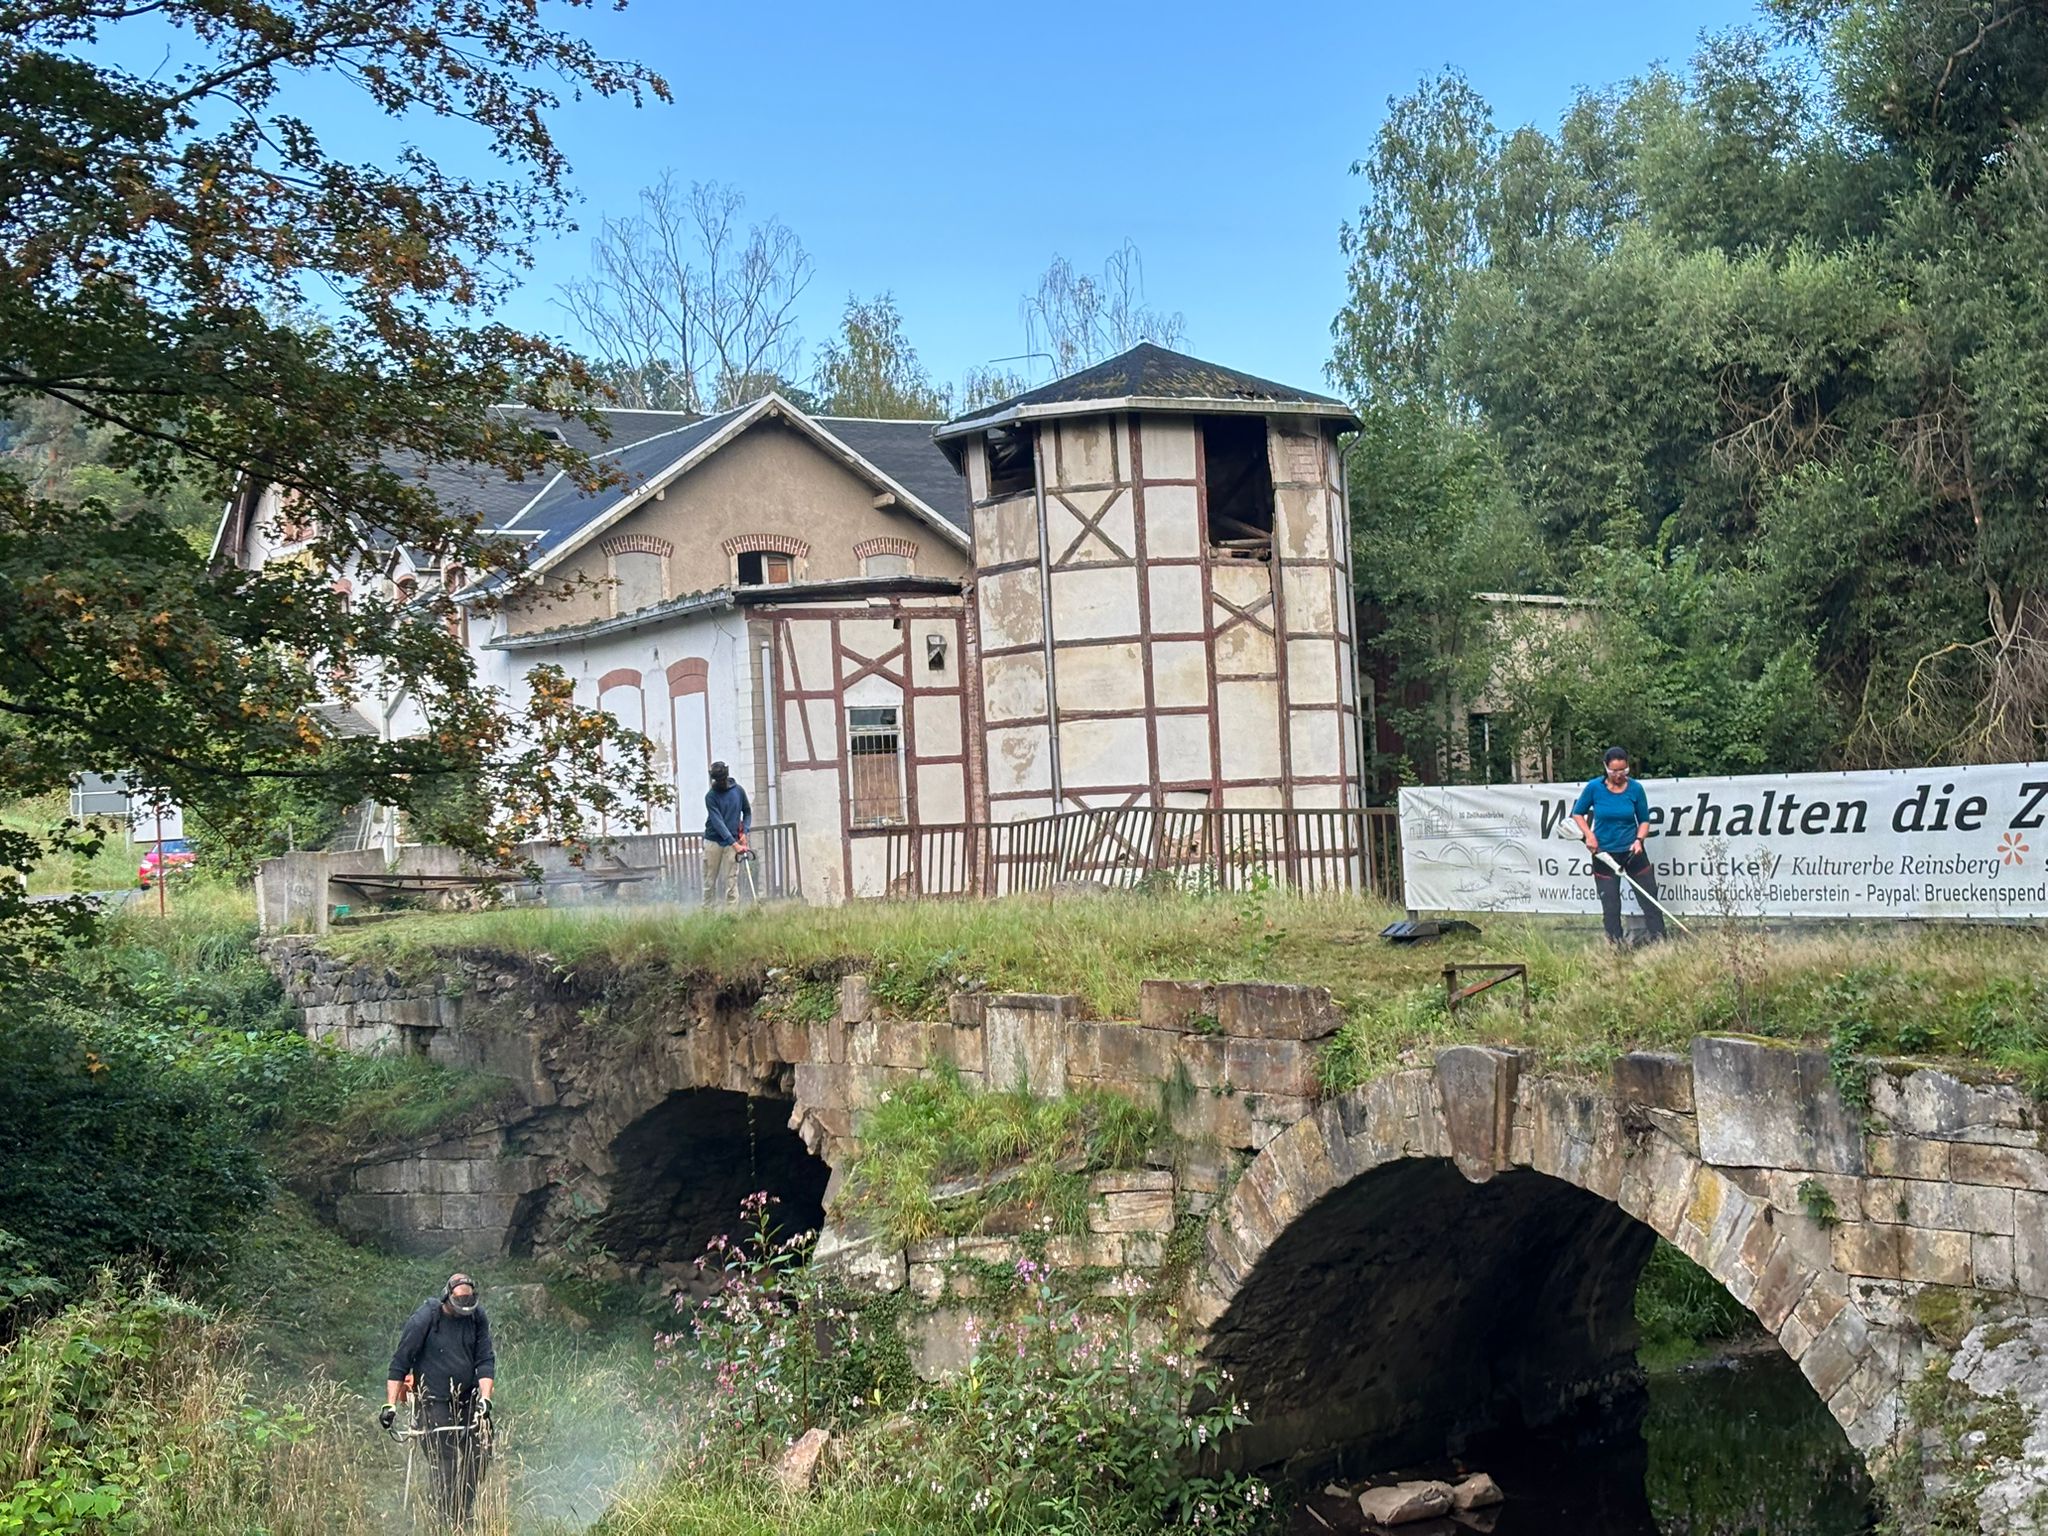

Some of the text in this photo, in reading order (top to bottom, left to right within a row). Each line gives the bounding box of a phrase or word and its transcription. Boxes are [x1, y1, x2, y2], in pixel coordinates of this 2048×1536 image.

[1648, 790, 1868, 837] erhalten
[1891, 783, 1988, 833] die
[2008, 781, 2048, 829] Z
[1538, 853, 2001, 880] IG Zosbrücke / Kulturerbe Reinsberg
[1867, 883, 1920, 907] Paypal:
[1925, 882, 2046, 906] Brueckenspend
